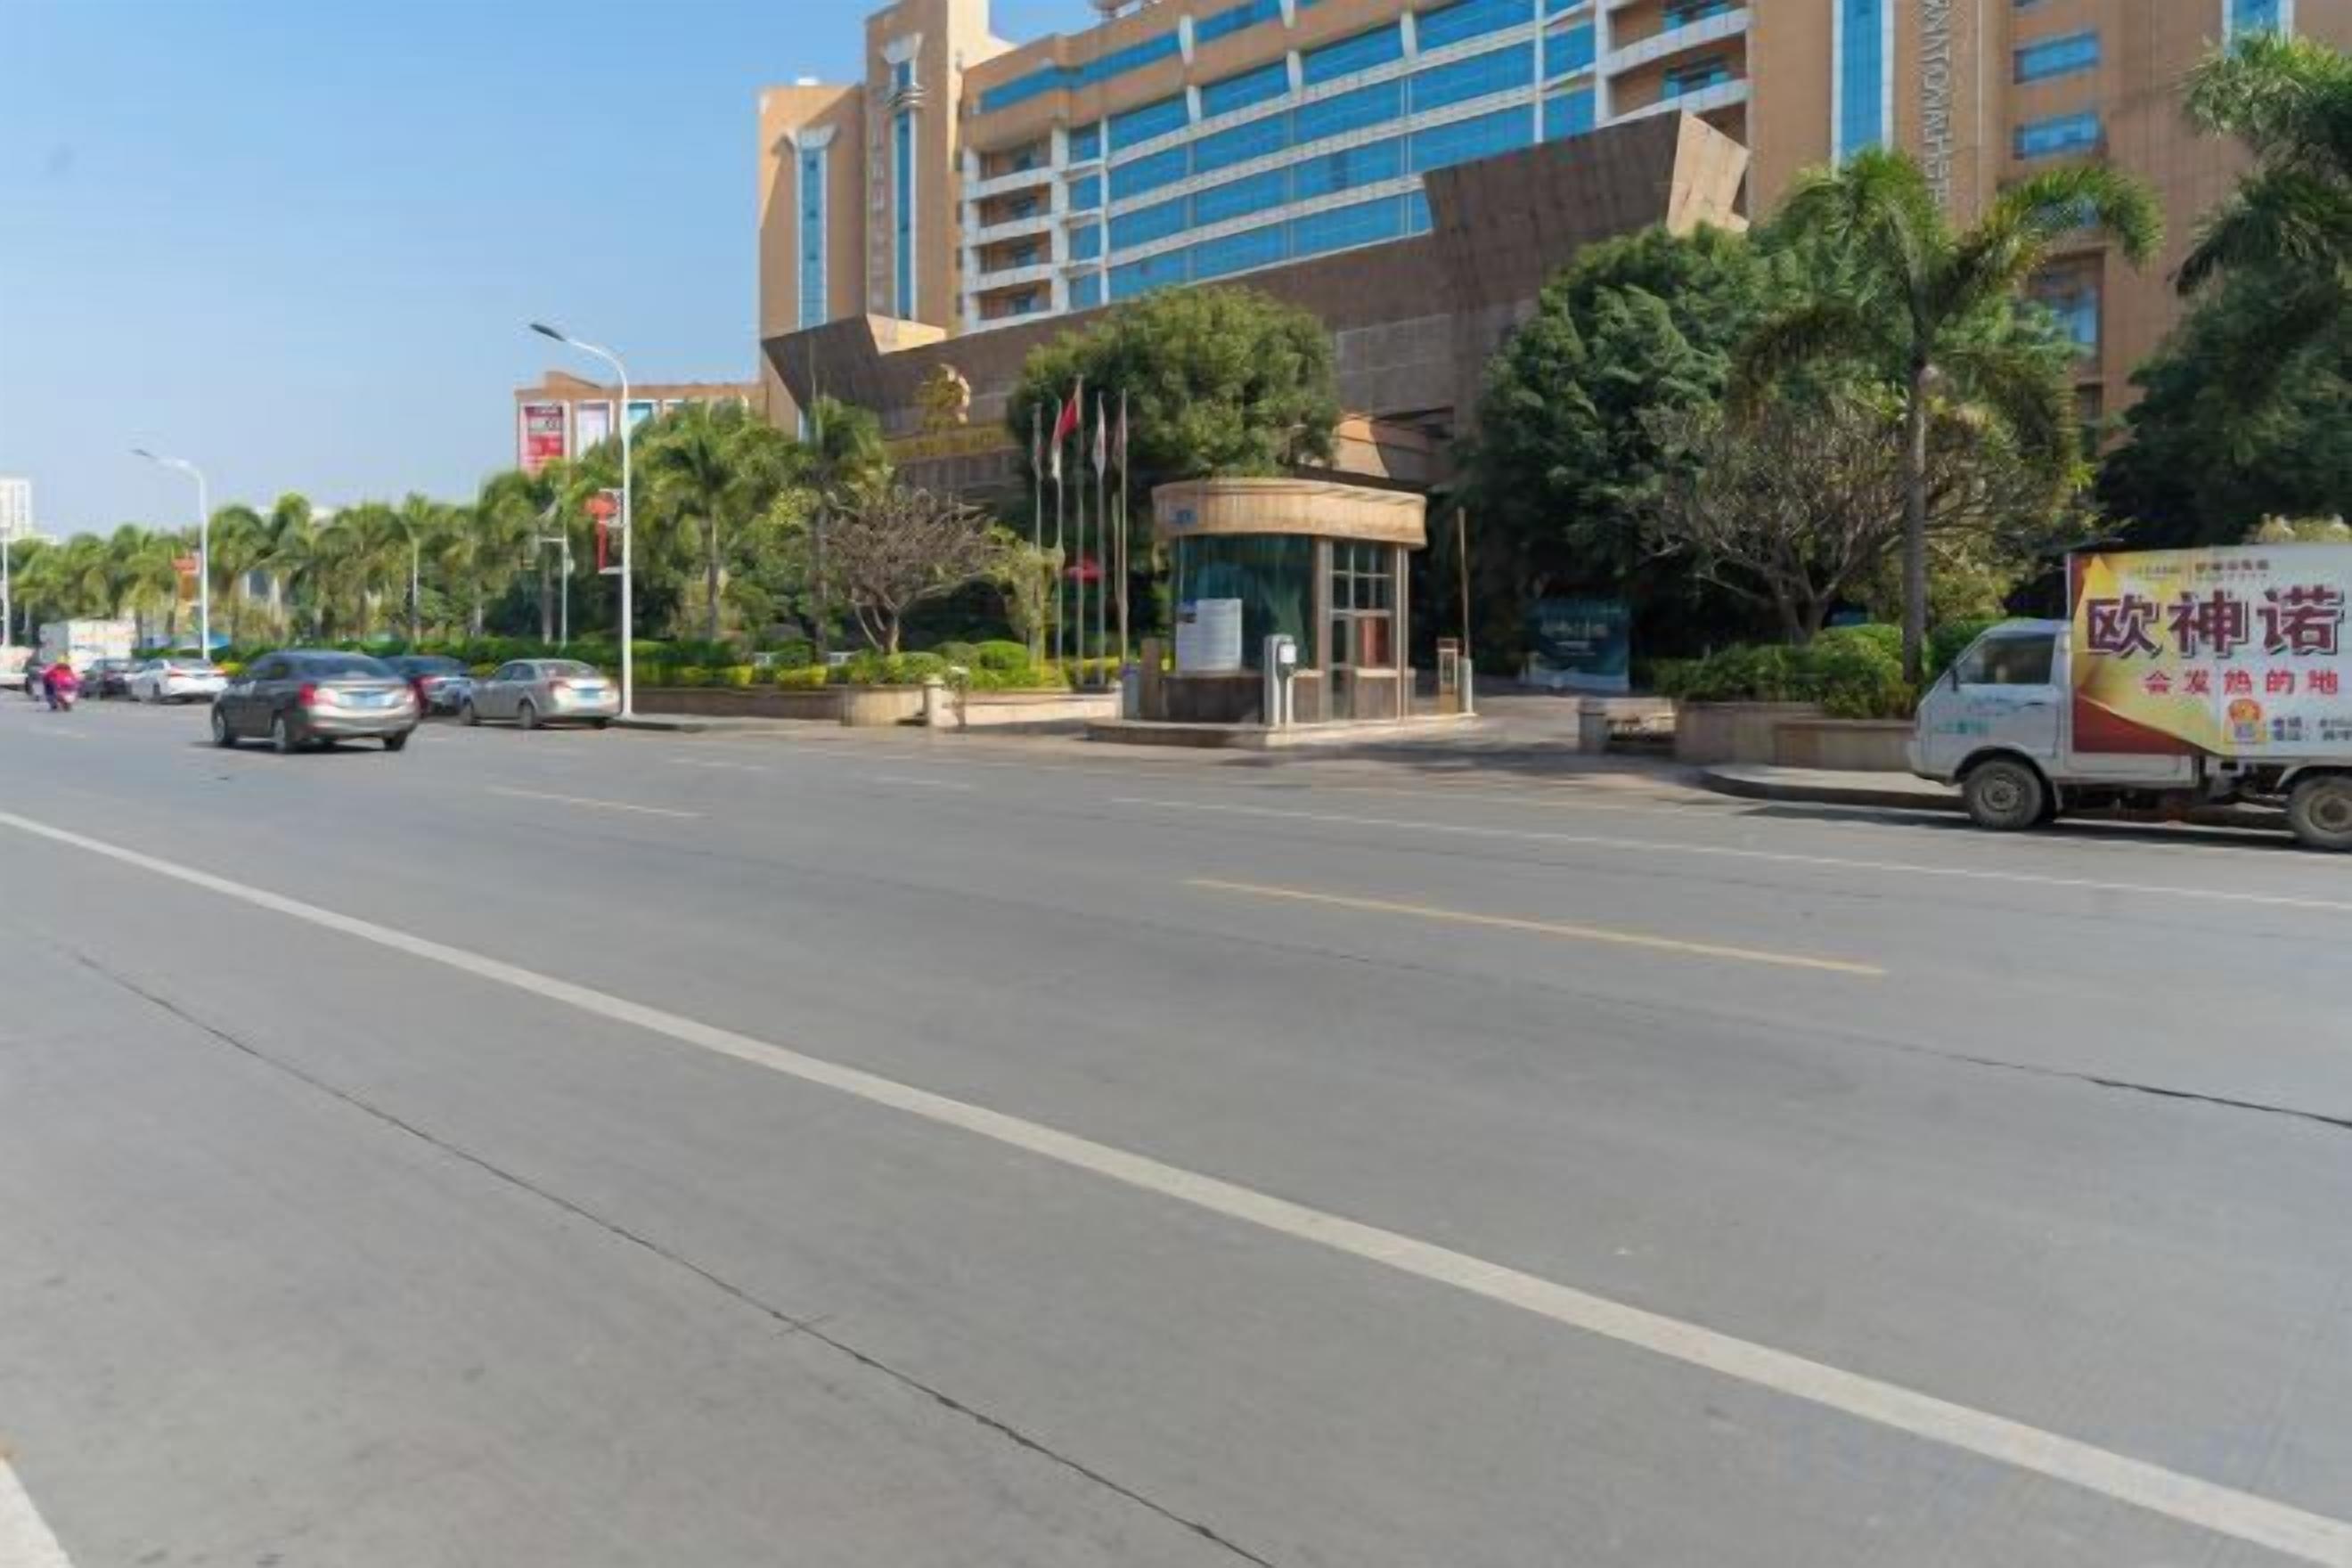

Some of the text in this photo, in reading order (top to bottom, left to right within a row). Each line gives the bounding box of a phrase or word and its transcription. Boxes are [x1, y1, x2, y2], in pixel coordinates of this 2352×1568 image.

[2086, 584, 2346, 659] 欧神诺
[2144, 668, 2339, 696] 会发热的地
